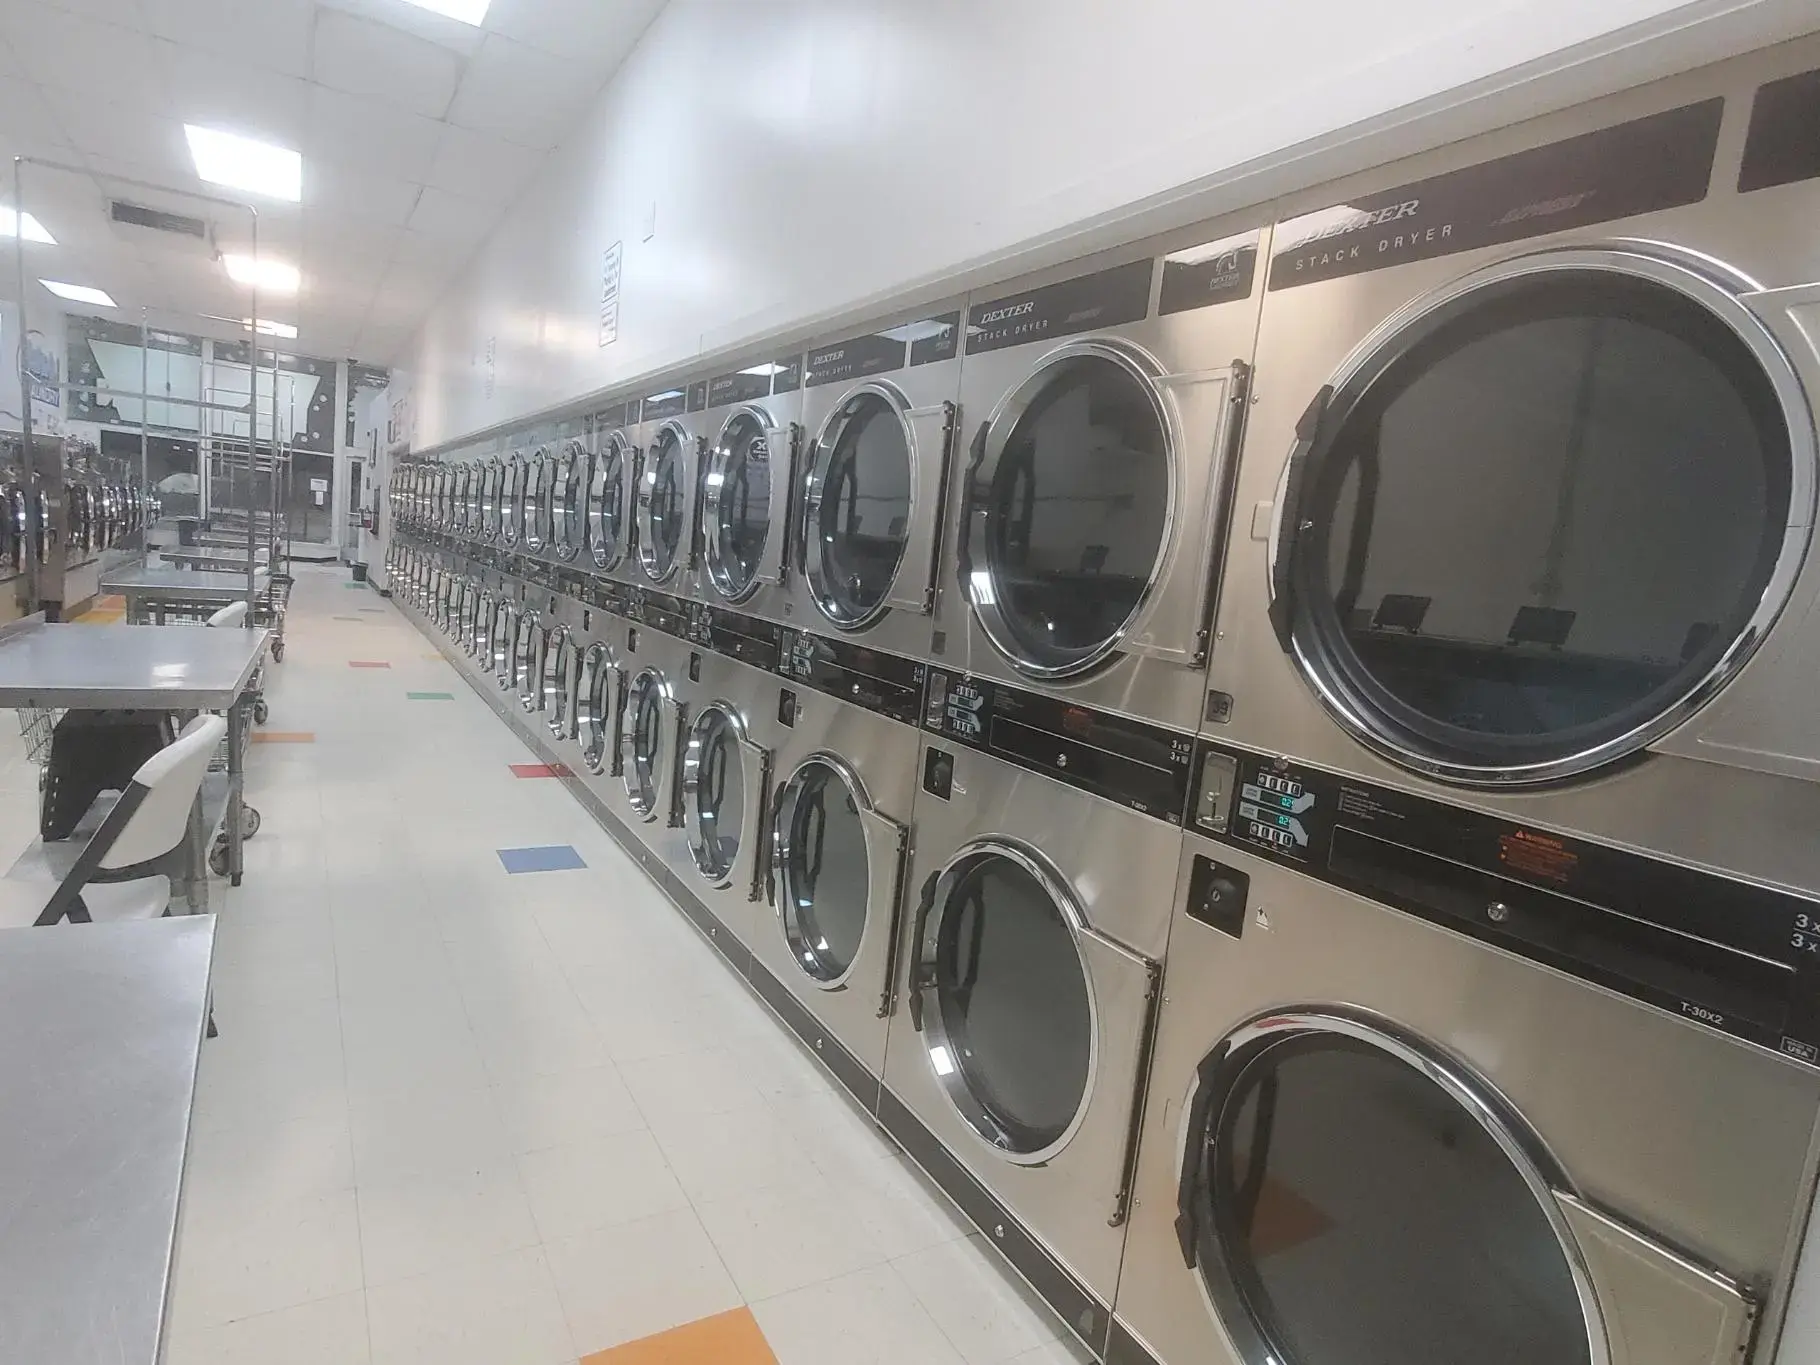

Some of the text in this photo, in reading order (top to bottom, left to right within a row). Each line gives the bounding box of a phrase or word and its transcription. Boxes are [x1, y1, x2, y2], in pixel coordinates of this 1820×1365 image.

[1295, 224, 1452, 270] STACK DRYER
[980, 301, 1034, 324] DEXTER
[977, 320, 1048, 342] STACK DRYER
[813, 350, 844, 365] DEXTER
[1795, 913, 1809, 928] 3
[1790, 933, 1818, 952] 3 x
[1681, 1001, 1724, 1025] T-30X2
[1787, 1045, 1809, 1058] USA
